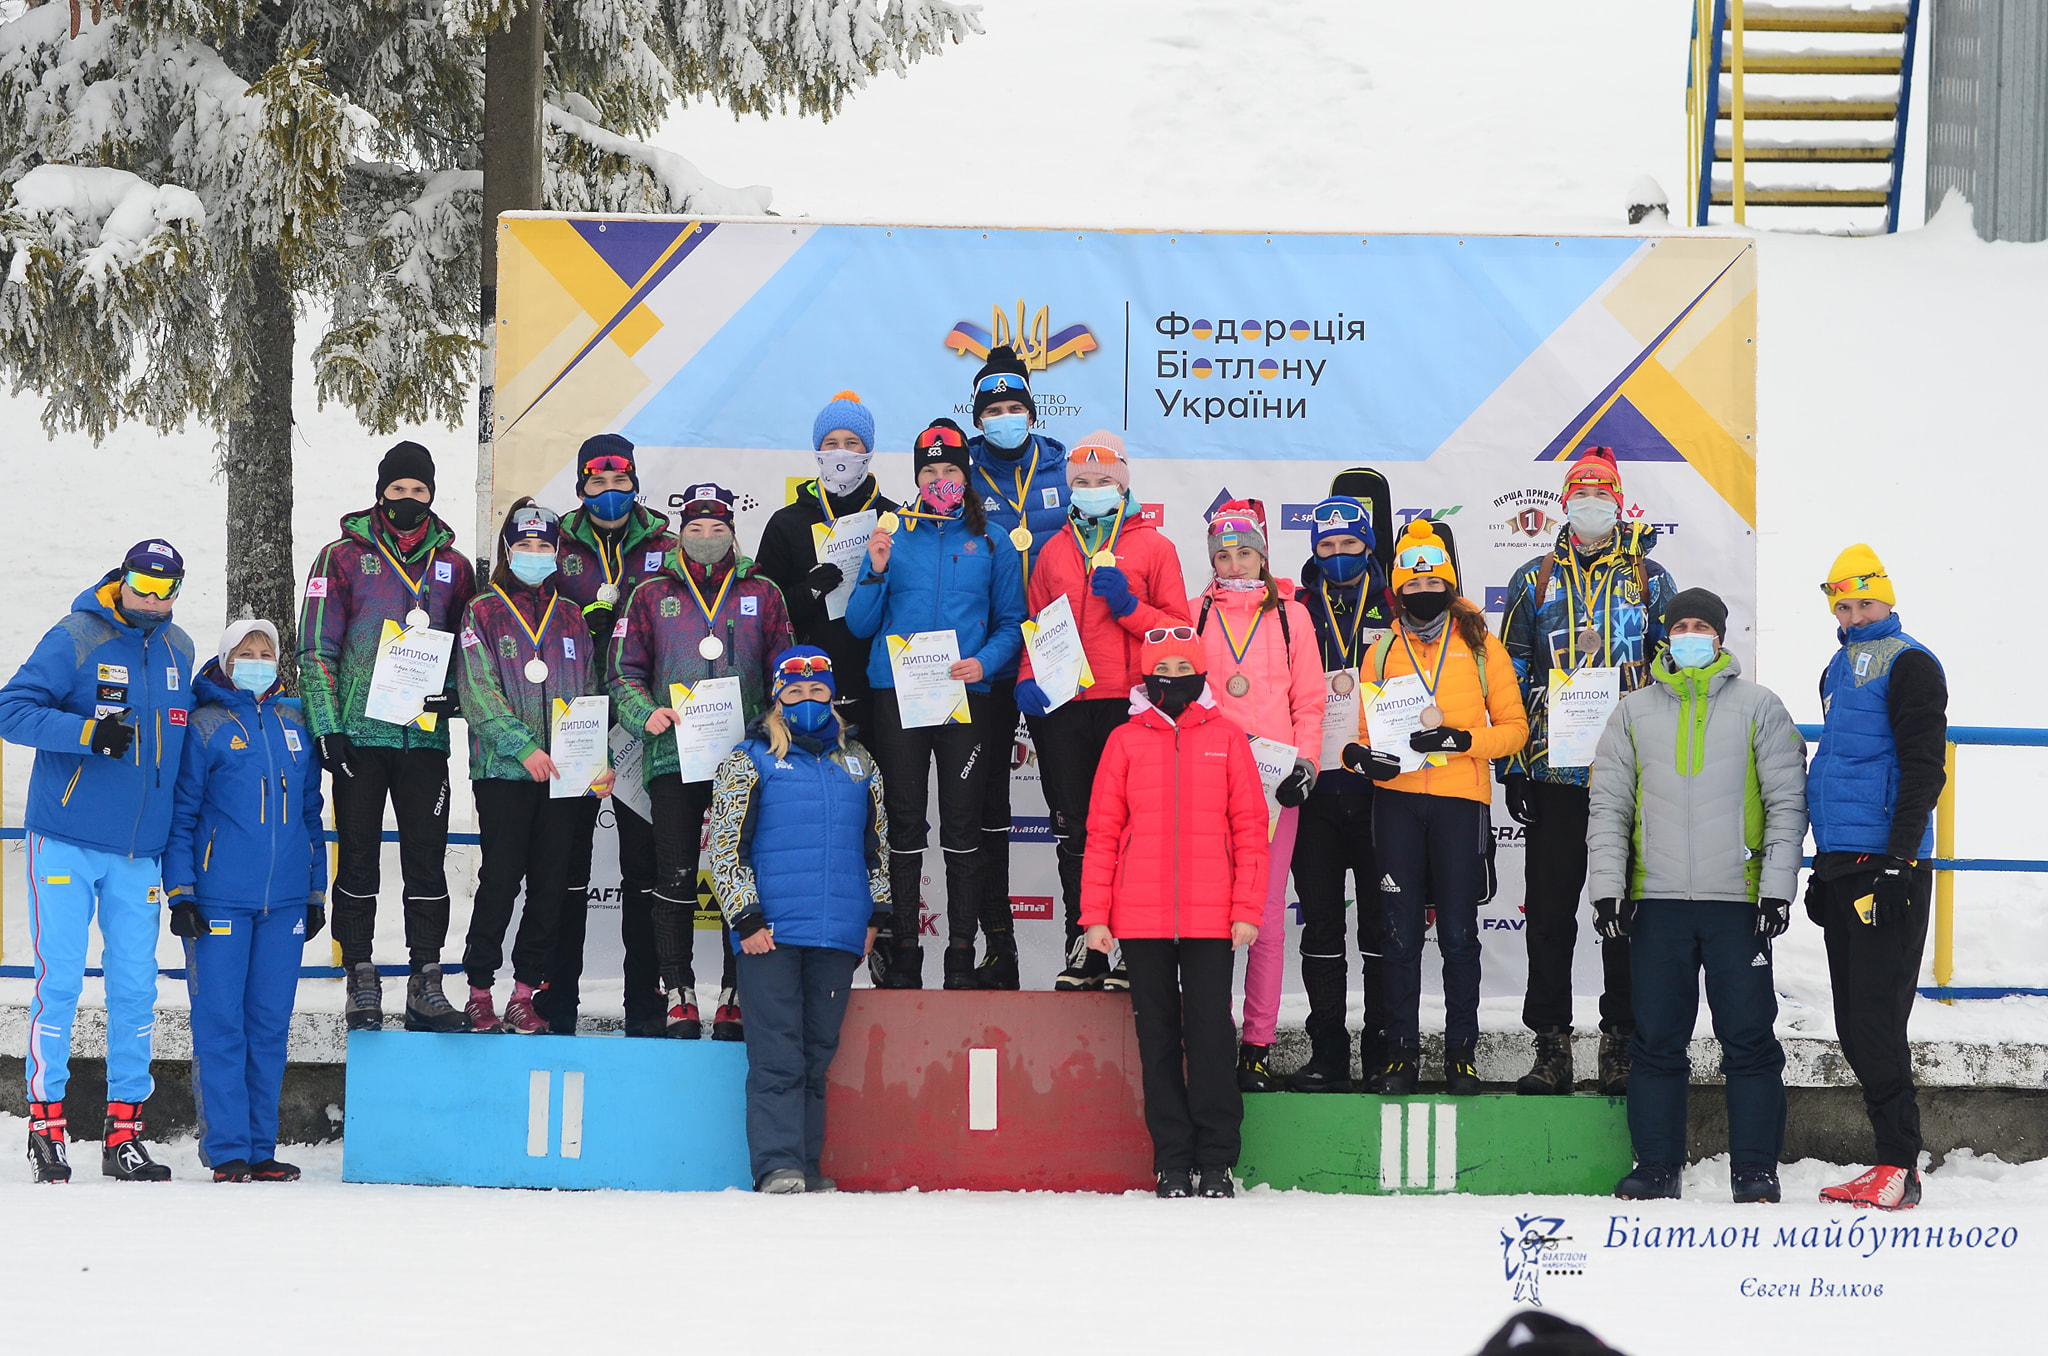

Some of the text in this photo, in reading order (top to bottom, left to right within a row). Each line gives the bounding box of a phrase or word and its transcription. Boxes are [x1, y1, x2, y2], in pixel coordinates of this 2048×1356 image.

[1155, 388, 1306, 425] України
[1526, 488, 1563, 505] ПРИВАТ
[1525, 512, 1538, 530] 1
[827, 534, 871, 554] ДИПЛОМ
[1035, 620, 1068, 648] ДИПЛОМ
[389, 646, 438, 663] ДИПЛОМ
[902, 654, 950, 666] ДИПЛОМ
[1376, 695, 1425, 713] ДИПЛОМ
[1560, 691, 1609, 701] ДИПЛОМ
[685, 701, 733, 716] ДИПЛОМ
[560, 720, 599, 732] ДИПЛОМ
[612, 737, 640, 770] ИПЛОМ
[960, 750, 978, 780] CRAFT
[1258, 762, 1282, 776] ЛОМ
[434, 785, 447, 816] CRAFT
[1009, 824, 1050, 834] tmaster
[585, 888, 621, 902] AFT
[1012, 903, 1046, 913] pina
[1483, 919, 1526, 930] FAV
